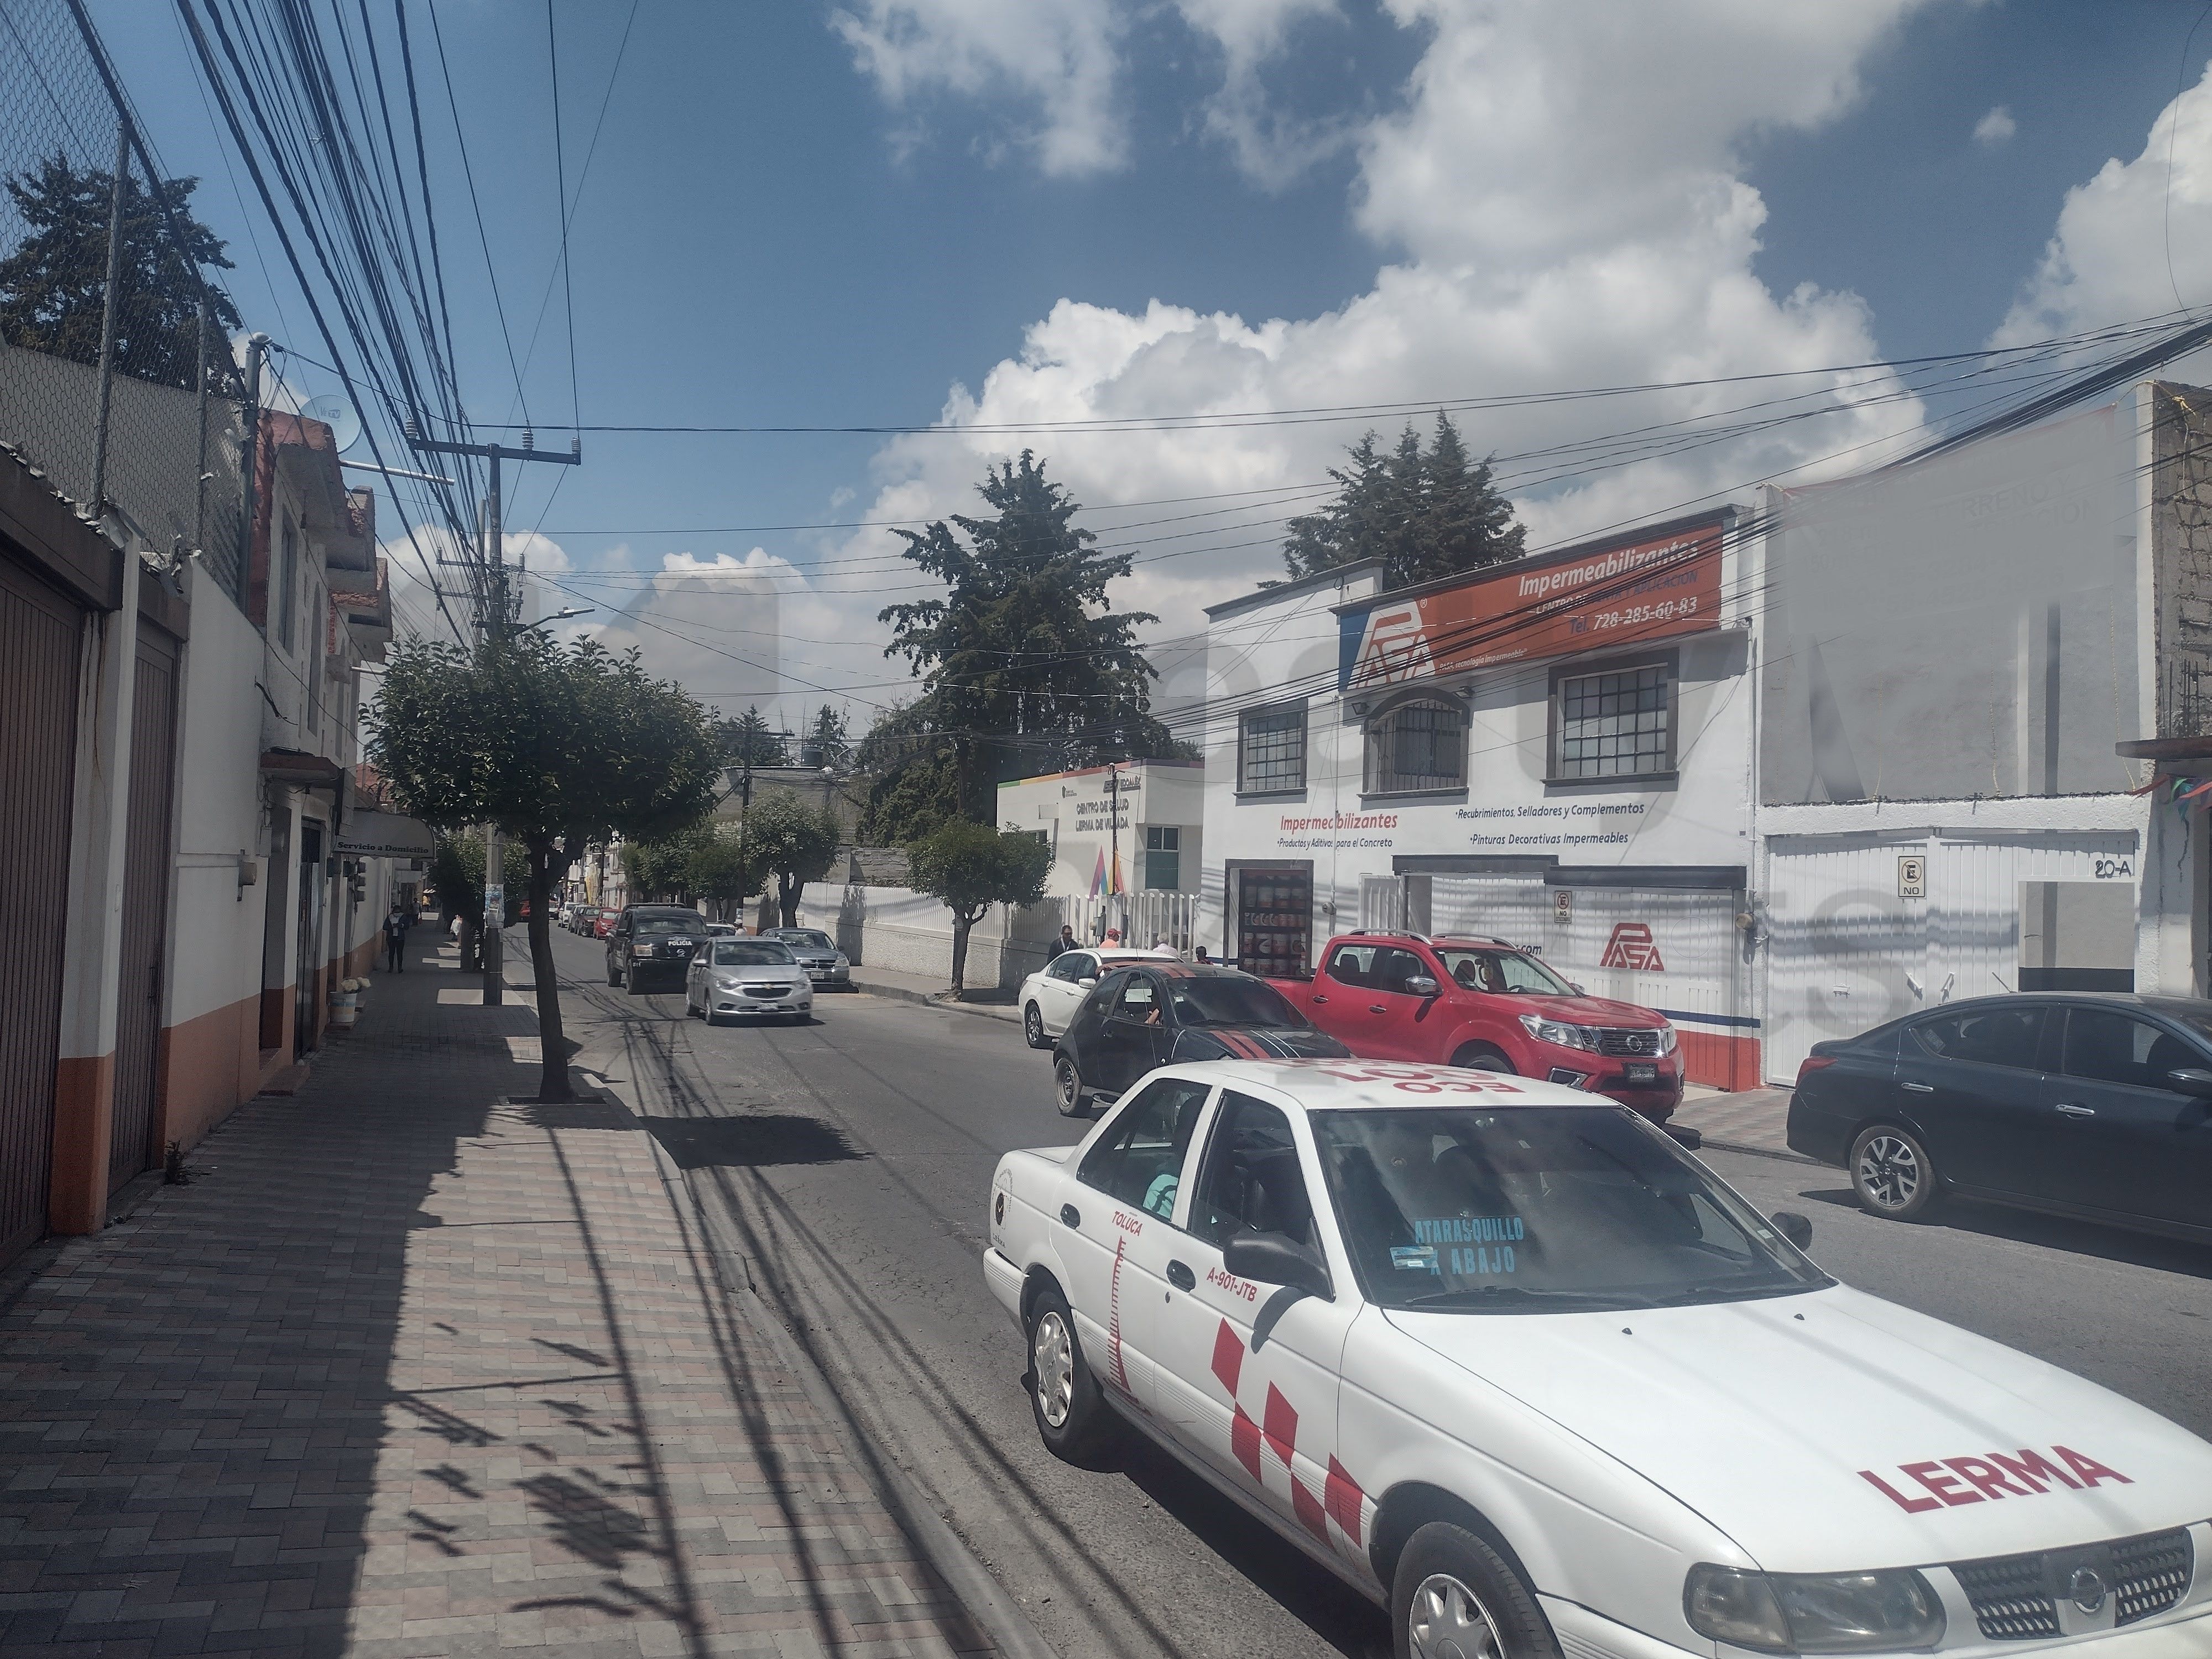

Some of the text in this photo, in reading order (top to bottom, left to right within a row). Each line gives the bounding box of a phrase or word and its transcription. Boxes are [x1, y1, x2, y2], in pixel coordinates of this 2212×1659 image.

[1519, 540, 1698, 598] Impermeabilizantes
[1593, 596, 1698, 630] 728-285-60-83
[1077, 798, 1129, 815] CENTRO DE SLUD
[1458, 803, 1645, 820] Recubrimientos, Selladores y Complementos
[1076, 816, 1129, 832] LERMA DE VILADA
[337, 842, 375, 851] Servicio
[385, 845, 429, 853] Domicilio
[1306, 841, 1311, 851] y
[1335, 841, 1351, 849] para
[1353, 838, 1358, 847] el
[1360, 838, 1392, 848] Concreto
[1472, 832, 1628, 847] Pinturas Decorativas Impermeables
[2095, 860, 2131, 878] 20-A
[1599, 922, 1665, 972] PASA
[1393, 1082, 1526, 1093] ECO
[1112, 1211, 1143, 1237] TOLUCA
[1415, 1217, 1524, 1244] ATARASQUILLO
[1451, 1246, 1515, 1275] ABAJO
[1207, 1267, 1258, 1302] A-901-JTB
[1856, 1446, 2135, 1514] LERMA
